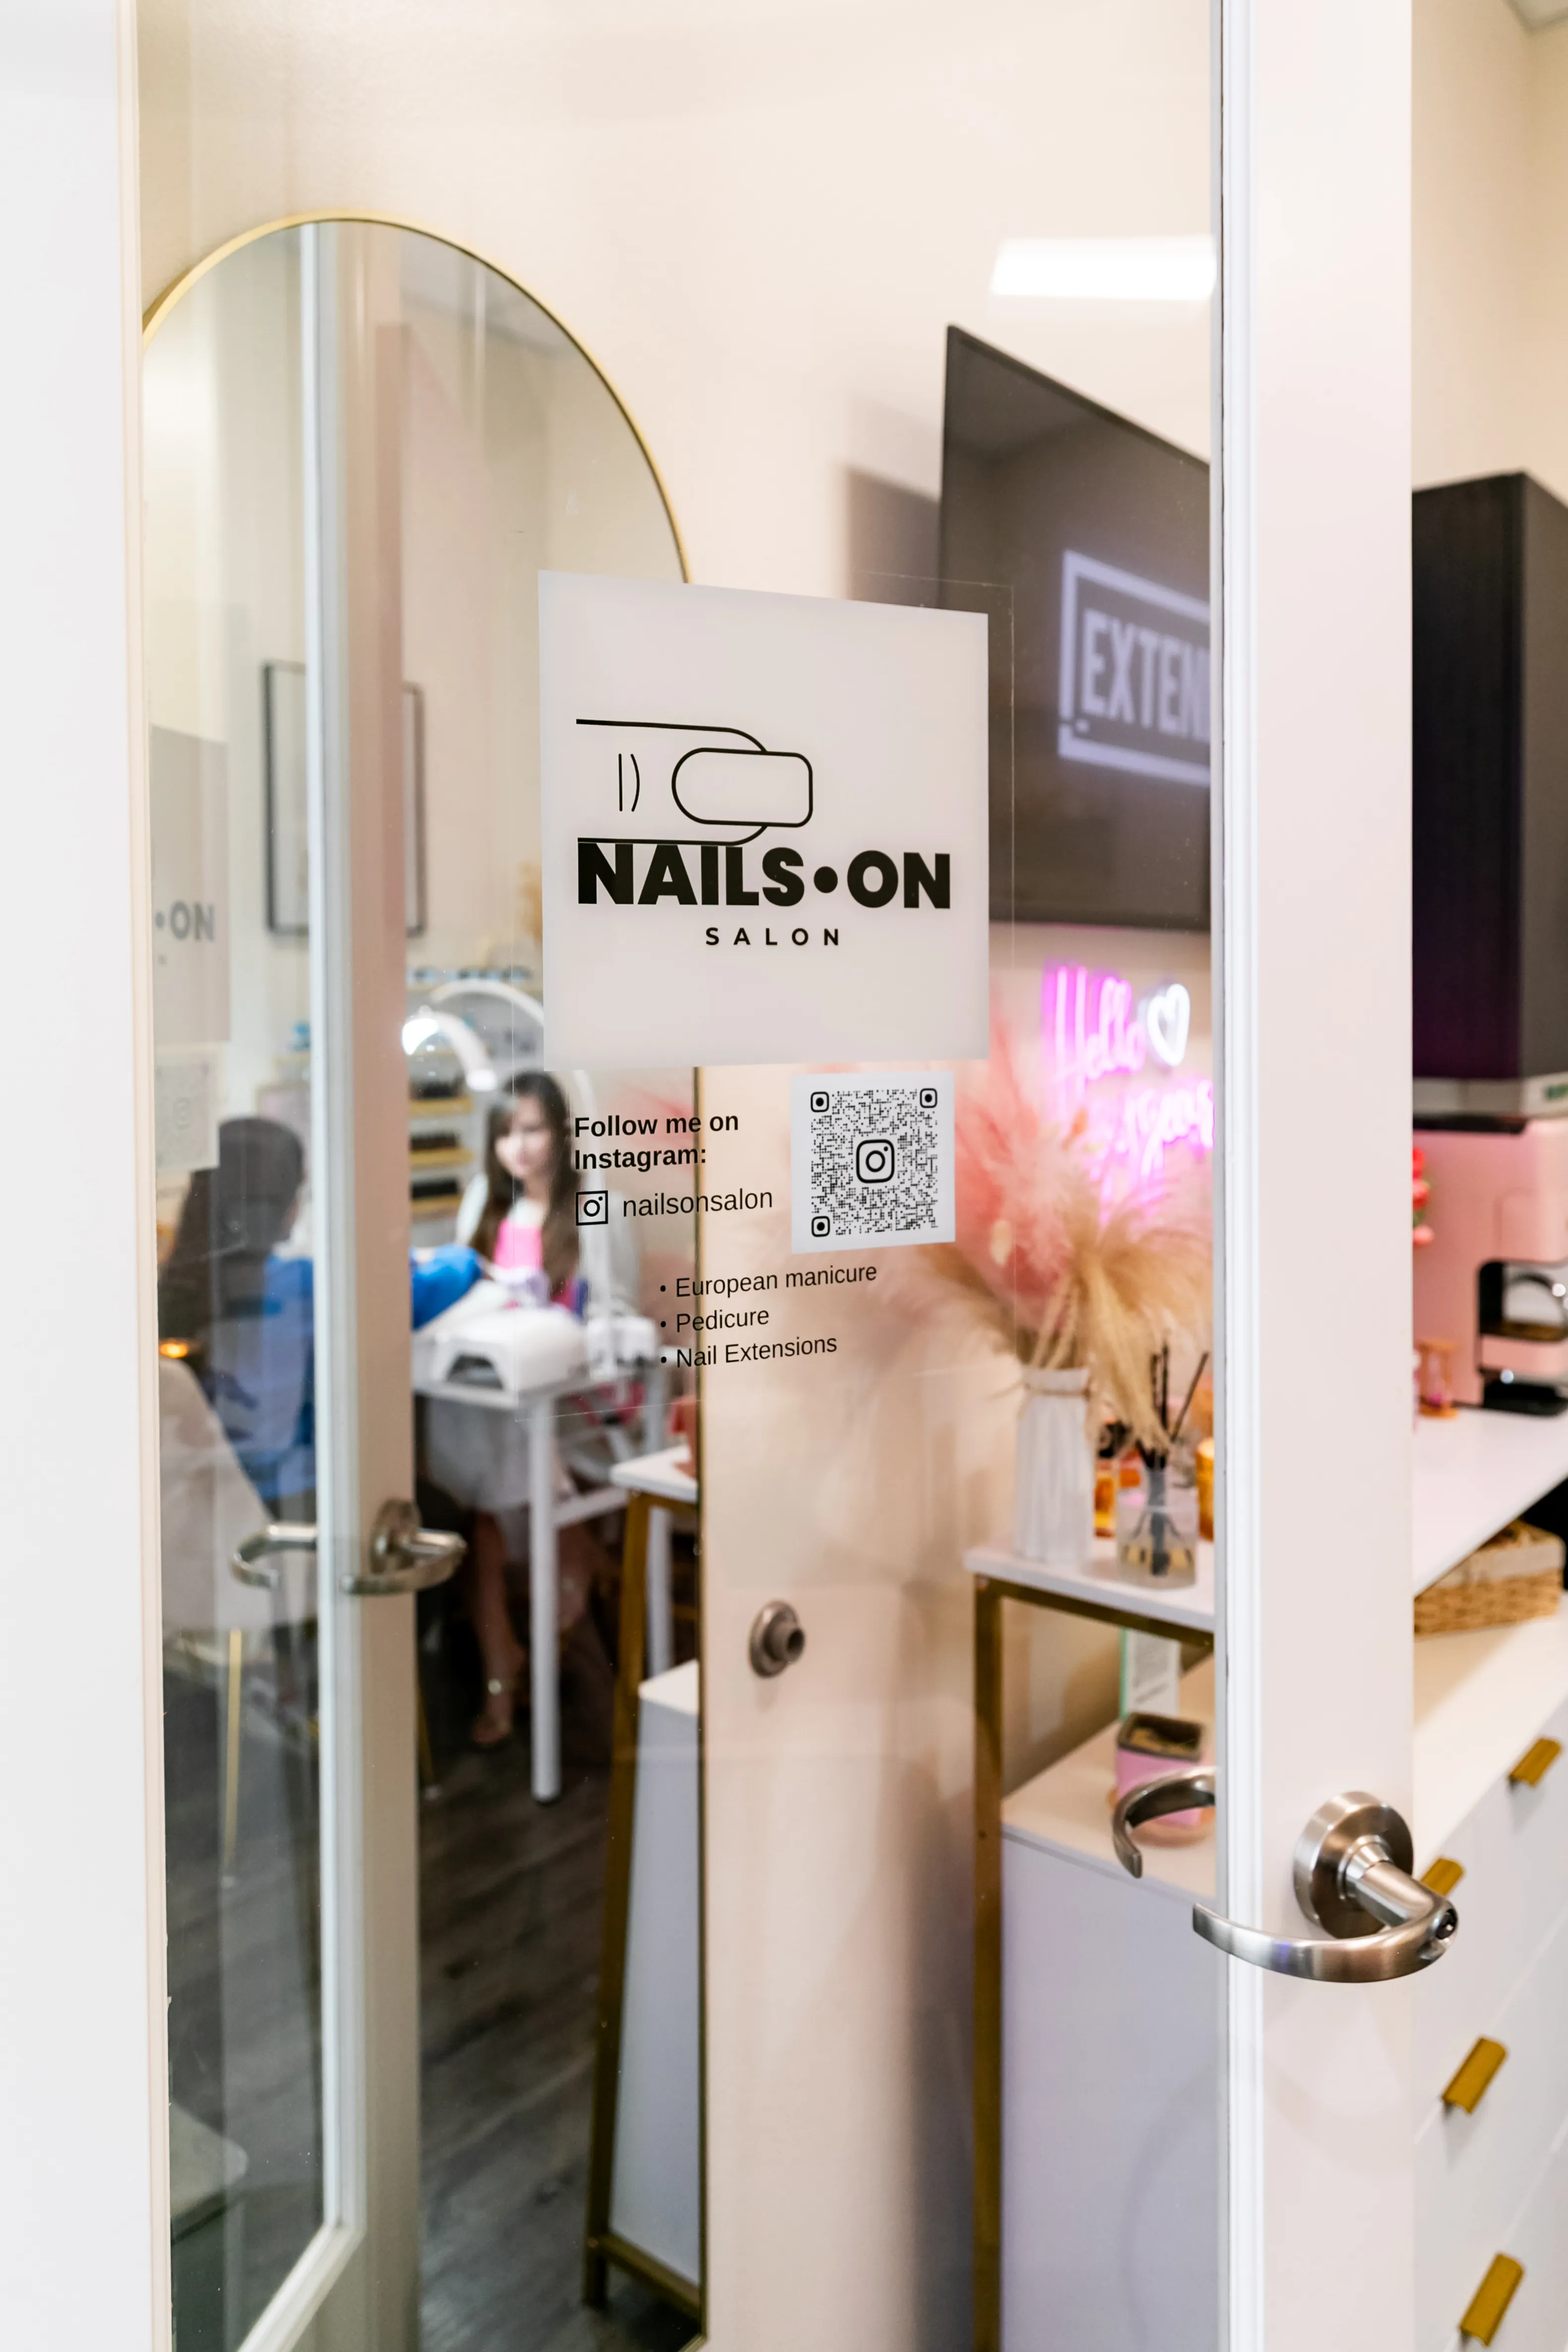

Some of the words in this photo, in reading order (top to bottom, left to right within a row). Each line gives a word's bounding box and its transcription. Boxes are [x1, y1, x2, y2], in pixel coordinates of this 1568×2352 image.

[705, 927, 839, 946] SALON
[575, 1115, 658, 1138] Follow
[666, 1117, 702, 1134] me
[709, 1115, 739, 1132] on
[575, 1148, 707, 1173] Instagram:
[623, 1188, 773, 1218] nailsonsalon
[676, 1274, 778, 1298] European
[786, 1264, 877, 1288] manicure
[676, 1307, 770, 1333] Pedicure
[676, 1345, 717, 1369] Nail
[725, 1337, 838, 1363] Extensions
